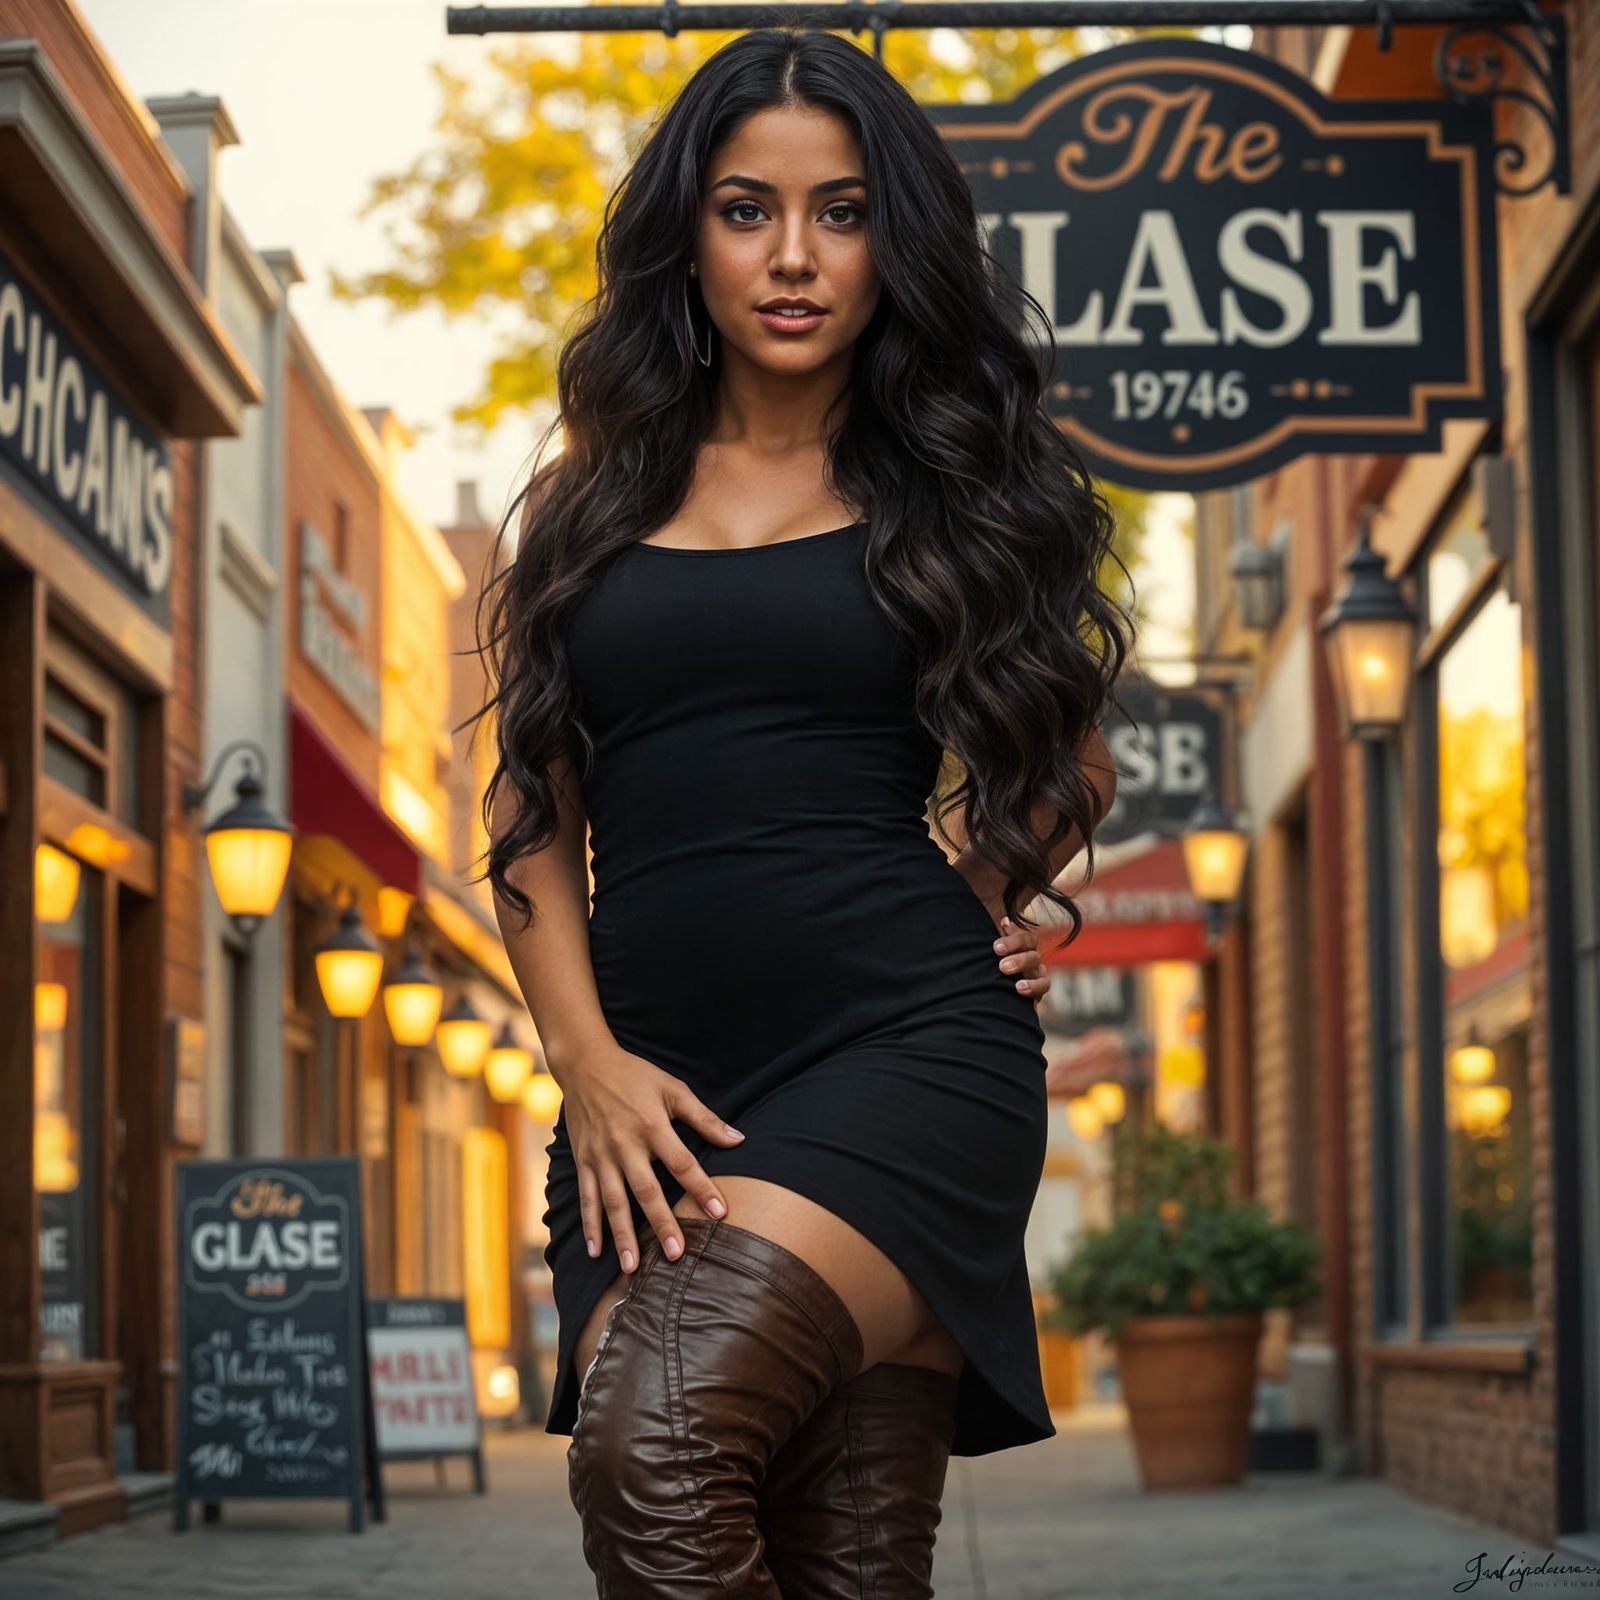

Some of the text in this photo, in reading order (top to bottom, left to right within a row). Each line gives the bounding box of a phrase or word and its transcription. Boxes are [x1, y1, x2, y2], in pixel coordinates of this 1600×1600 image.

[1056, 84, 1282, 190] The
[975, 208, 1421, 347] LASE
[1110, 371, 1248, 419] 19746
[191, 1221, 341, 1272] GLASE
